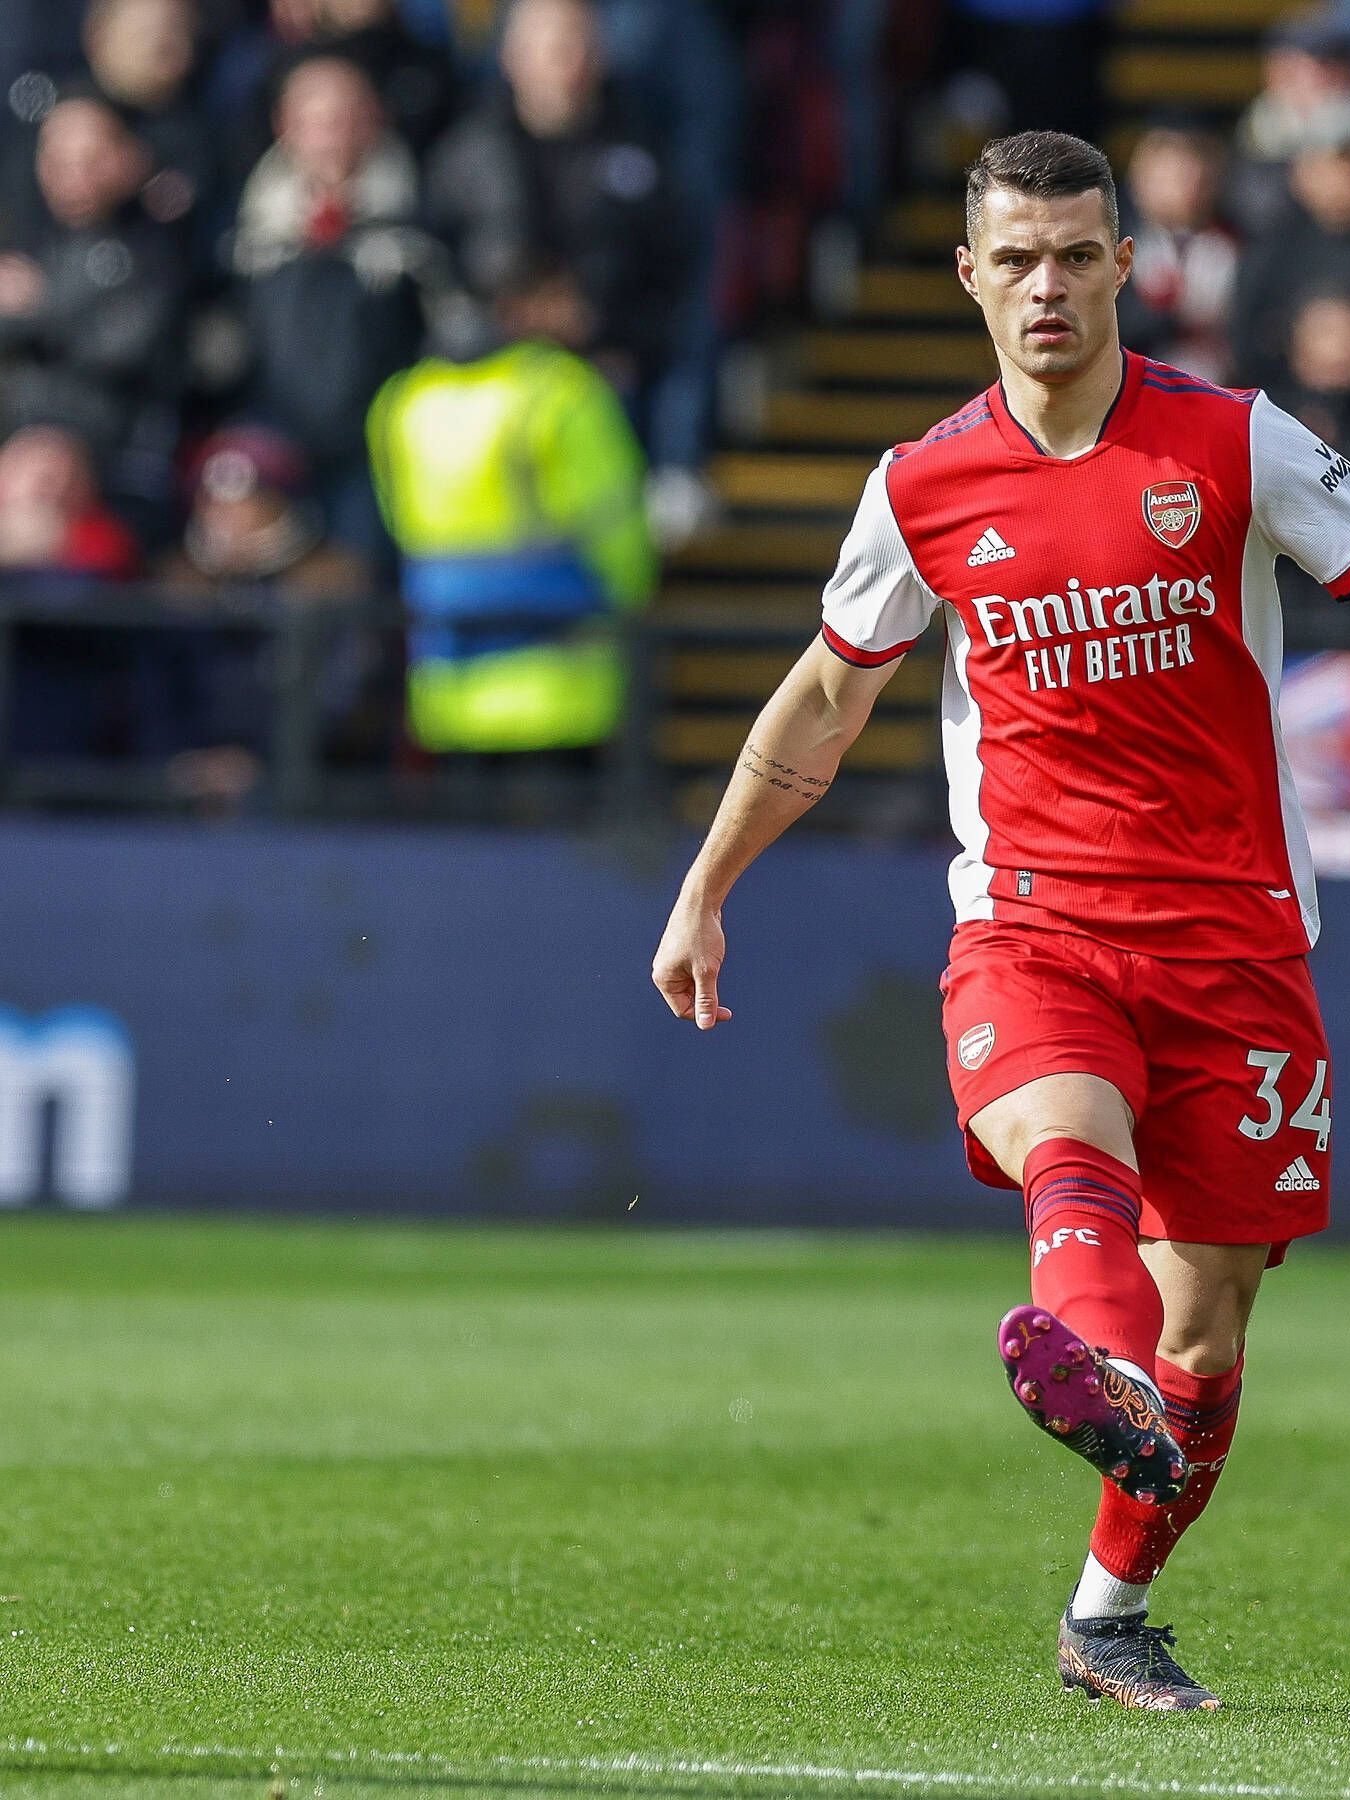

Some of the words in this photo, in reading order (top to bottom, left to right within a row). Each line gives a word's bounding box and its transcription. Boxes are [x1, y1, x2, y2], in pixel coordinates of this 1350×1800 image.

[1150, 490, 1191, 507] Arsenal
[967, 547, 1016, 567] adidas
[971, 573, 1216, 648] Emirates
[1025, 644, 1071, 692] FLY
[1087, 623, 1195, 683] BETTER
[1238, 1048, 1332, 1152] 34
[1275, 1177, 1321, 1192] adidas
[1033, 1227, 1102, 1269] AFC
